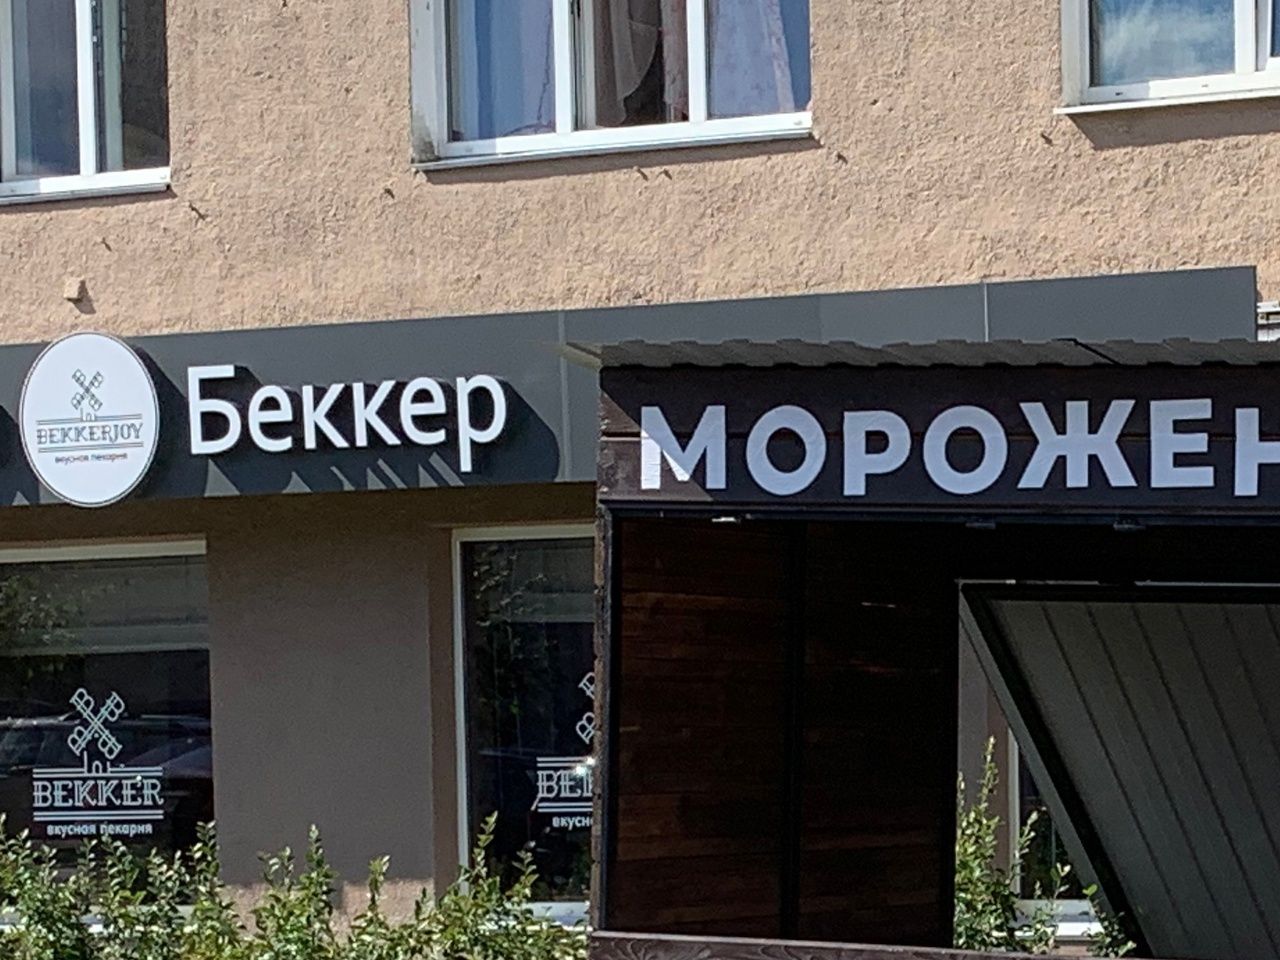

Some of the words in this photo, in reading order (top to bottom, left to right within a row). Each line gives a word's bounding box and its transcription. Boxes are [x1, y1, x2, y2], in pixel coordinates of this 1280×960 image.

[187, 364, 507, 473] Беккер
[36, 422, 143, 445] BEKKERJOY
[33, 779, 164, 807] BEKKER
[47, 824, 96, 838] вкусная
[100, 823, 153, 838] пекарня
